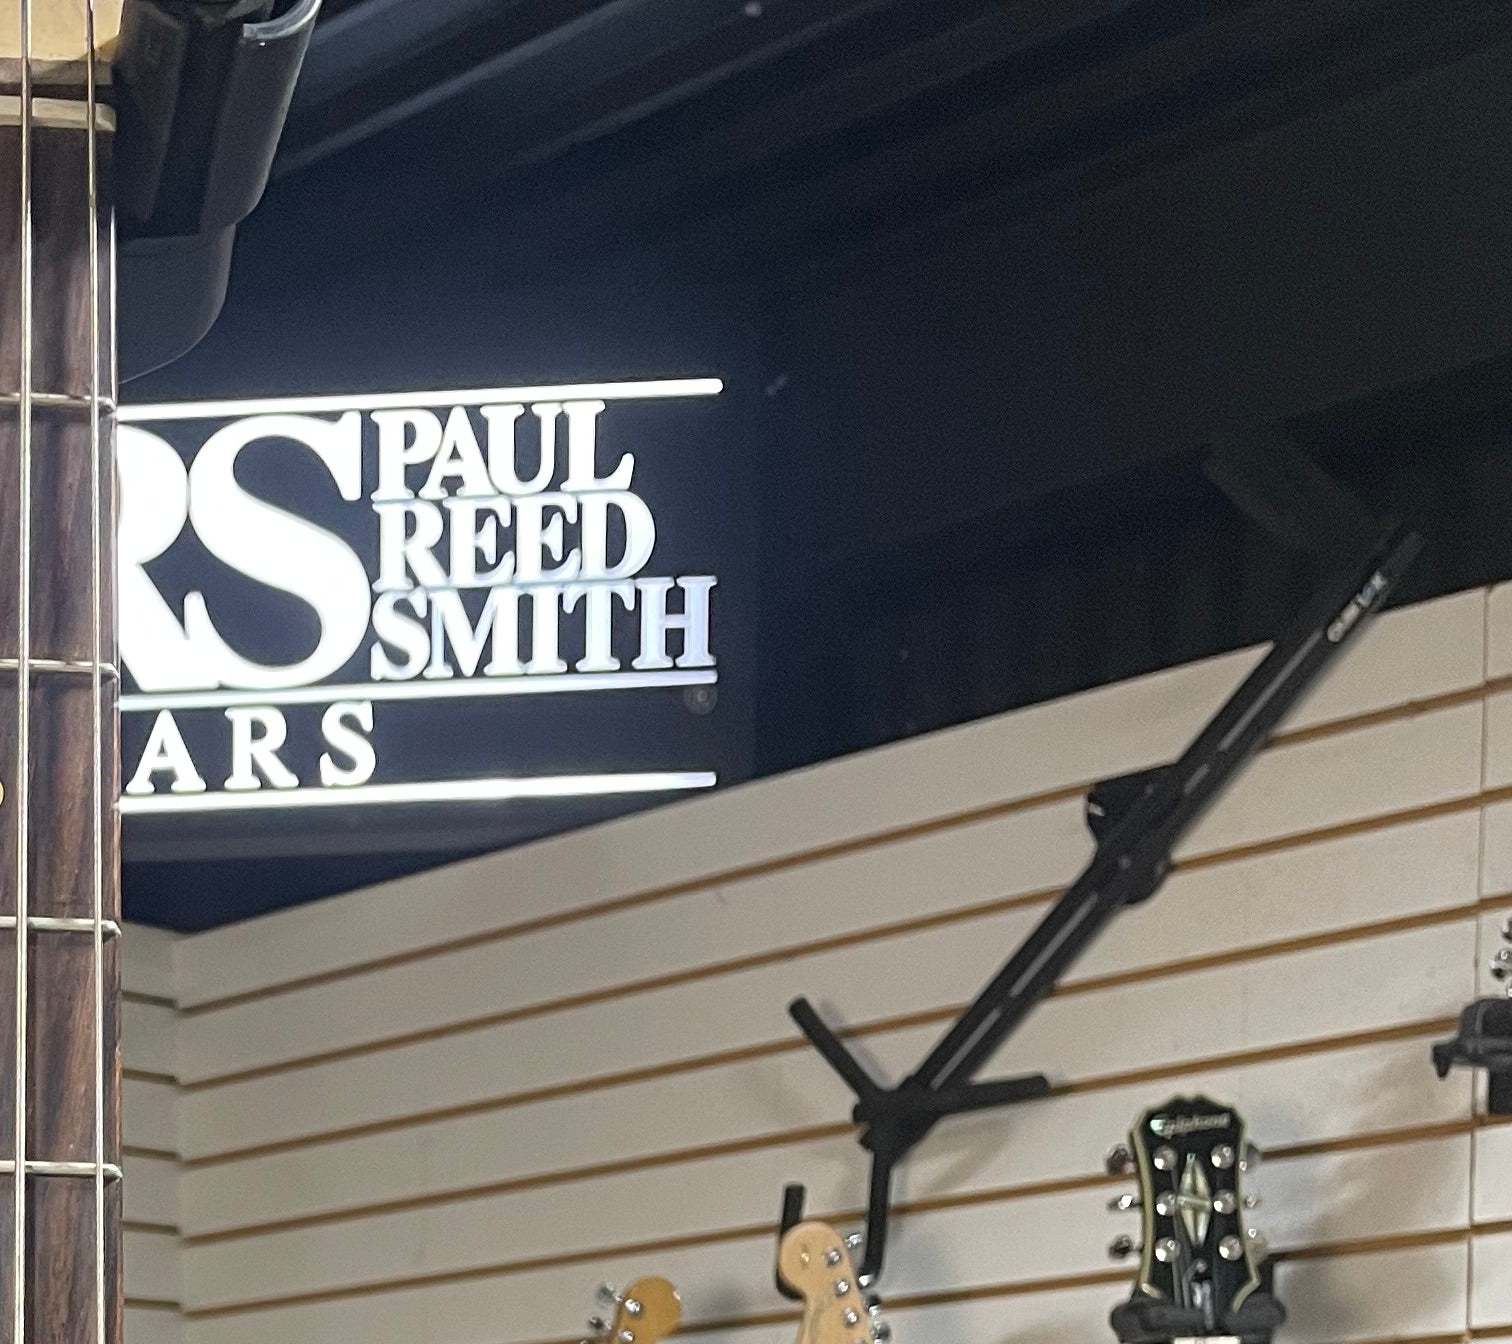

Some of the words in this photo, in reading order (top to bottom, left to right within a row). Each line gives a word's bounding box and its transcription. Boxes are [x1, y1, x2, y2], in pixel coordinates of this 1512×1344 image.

[371, 400, 635, 500] PAUL
[371, 490, 656, 592] REED
[370, 575, 719, 681] SMITH
